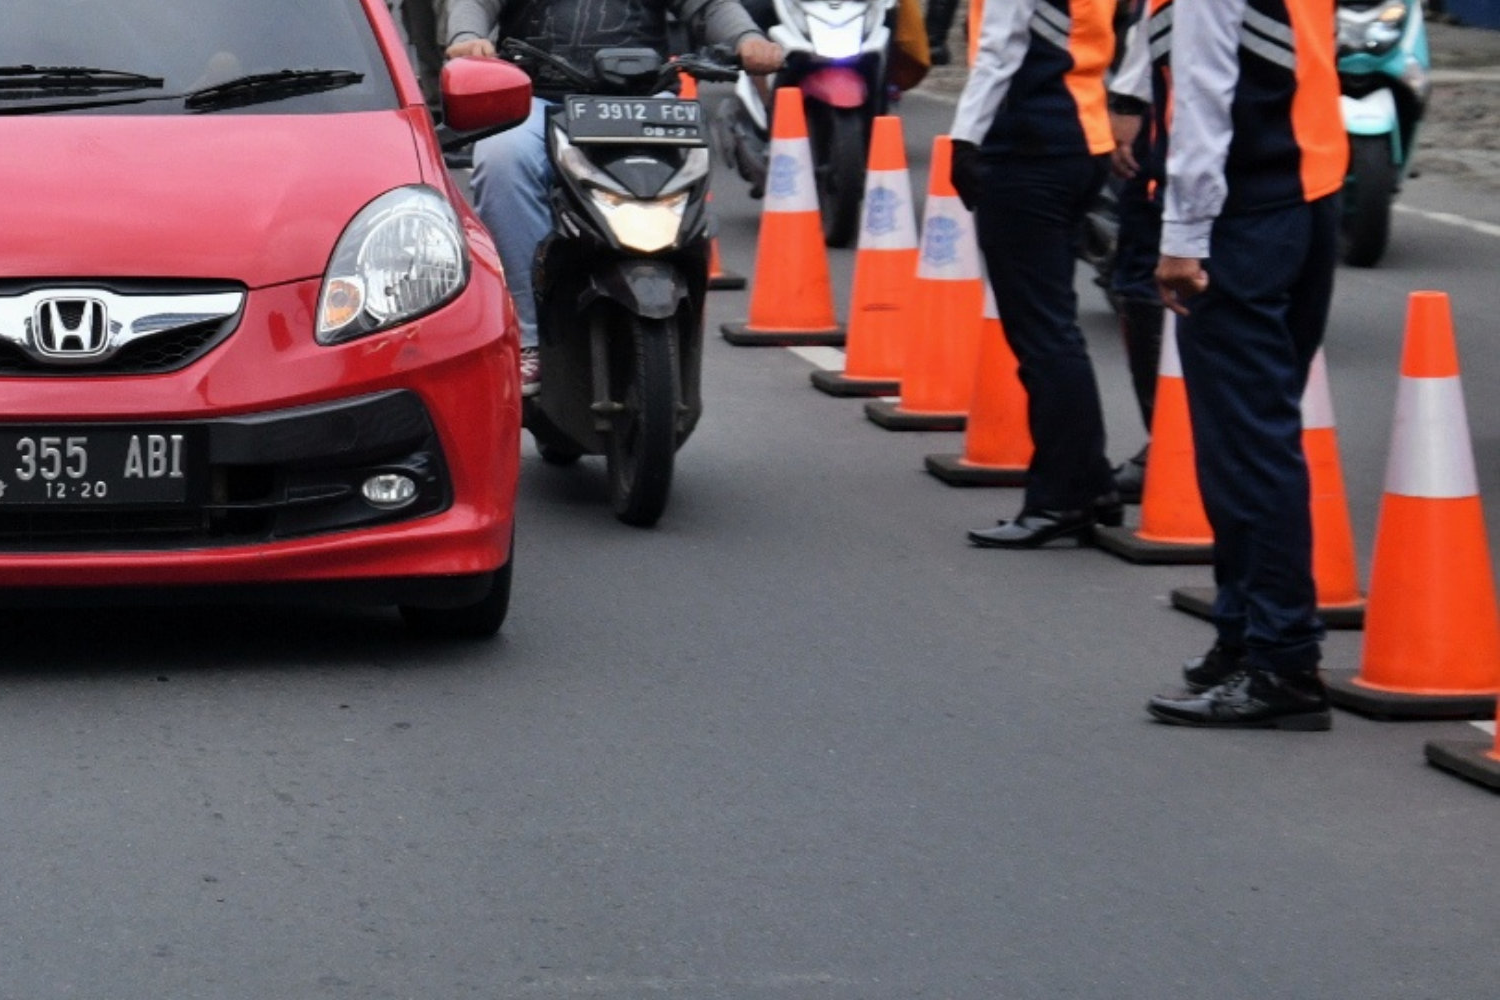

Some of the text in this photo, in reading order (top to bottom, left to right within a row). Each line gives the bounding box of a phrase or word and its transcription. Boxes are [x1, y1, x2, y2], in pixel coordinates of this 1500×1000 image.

[574, 103, 696, 120] F 3912 FCV
[15, 436, 88, 481] 355
[123, 434, 184, 479] ABI
